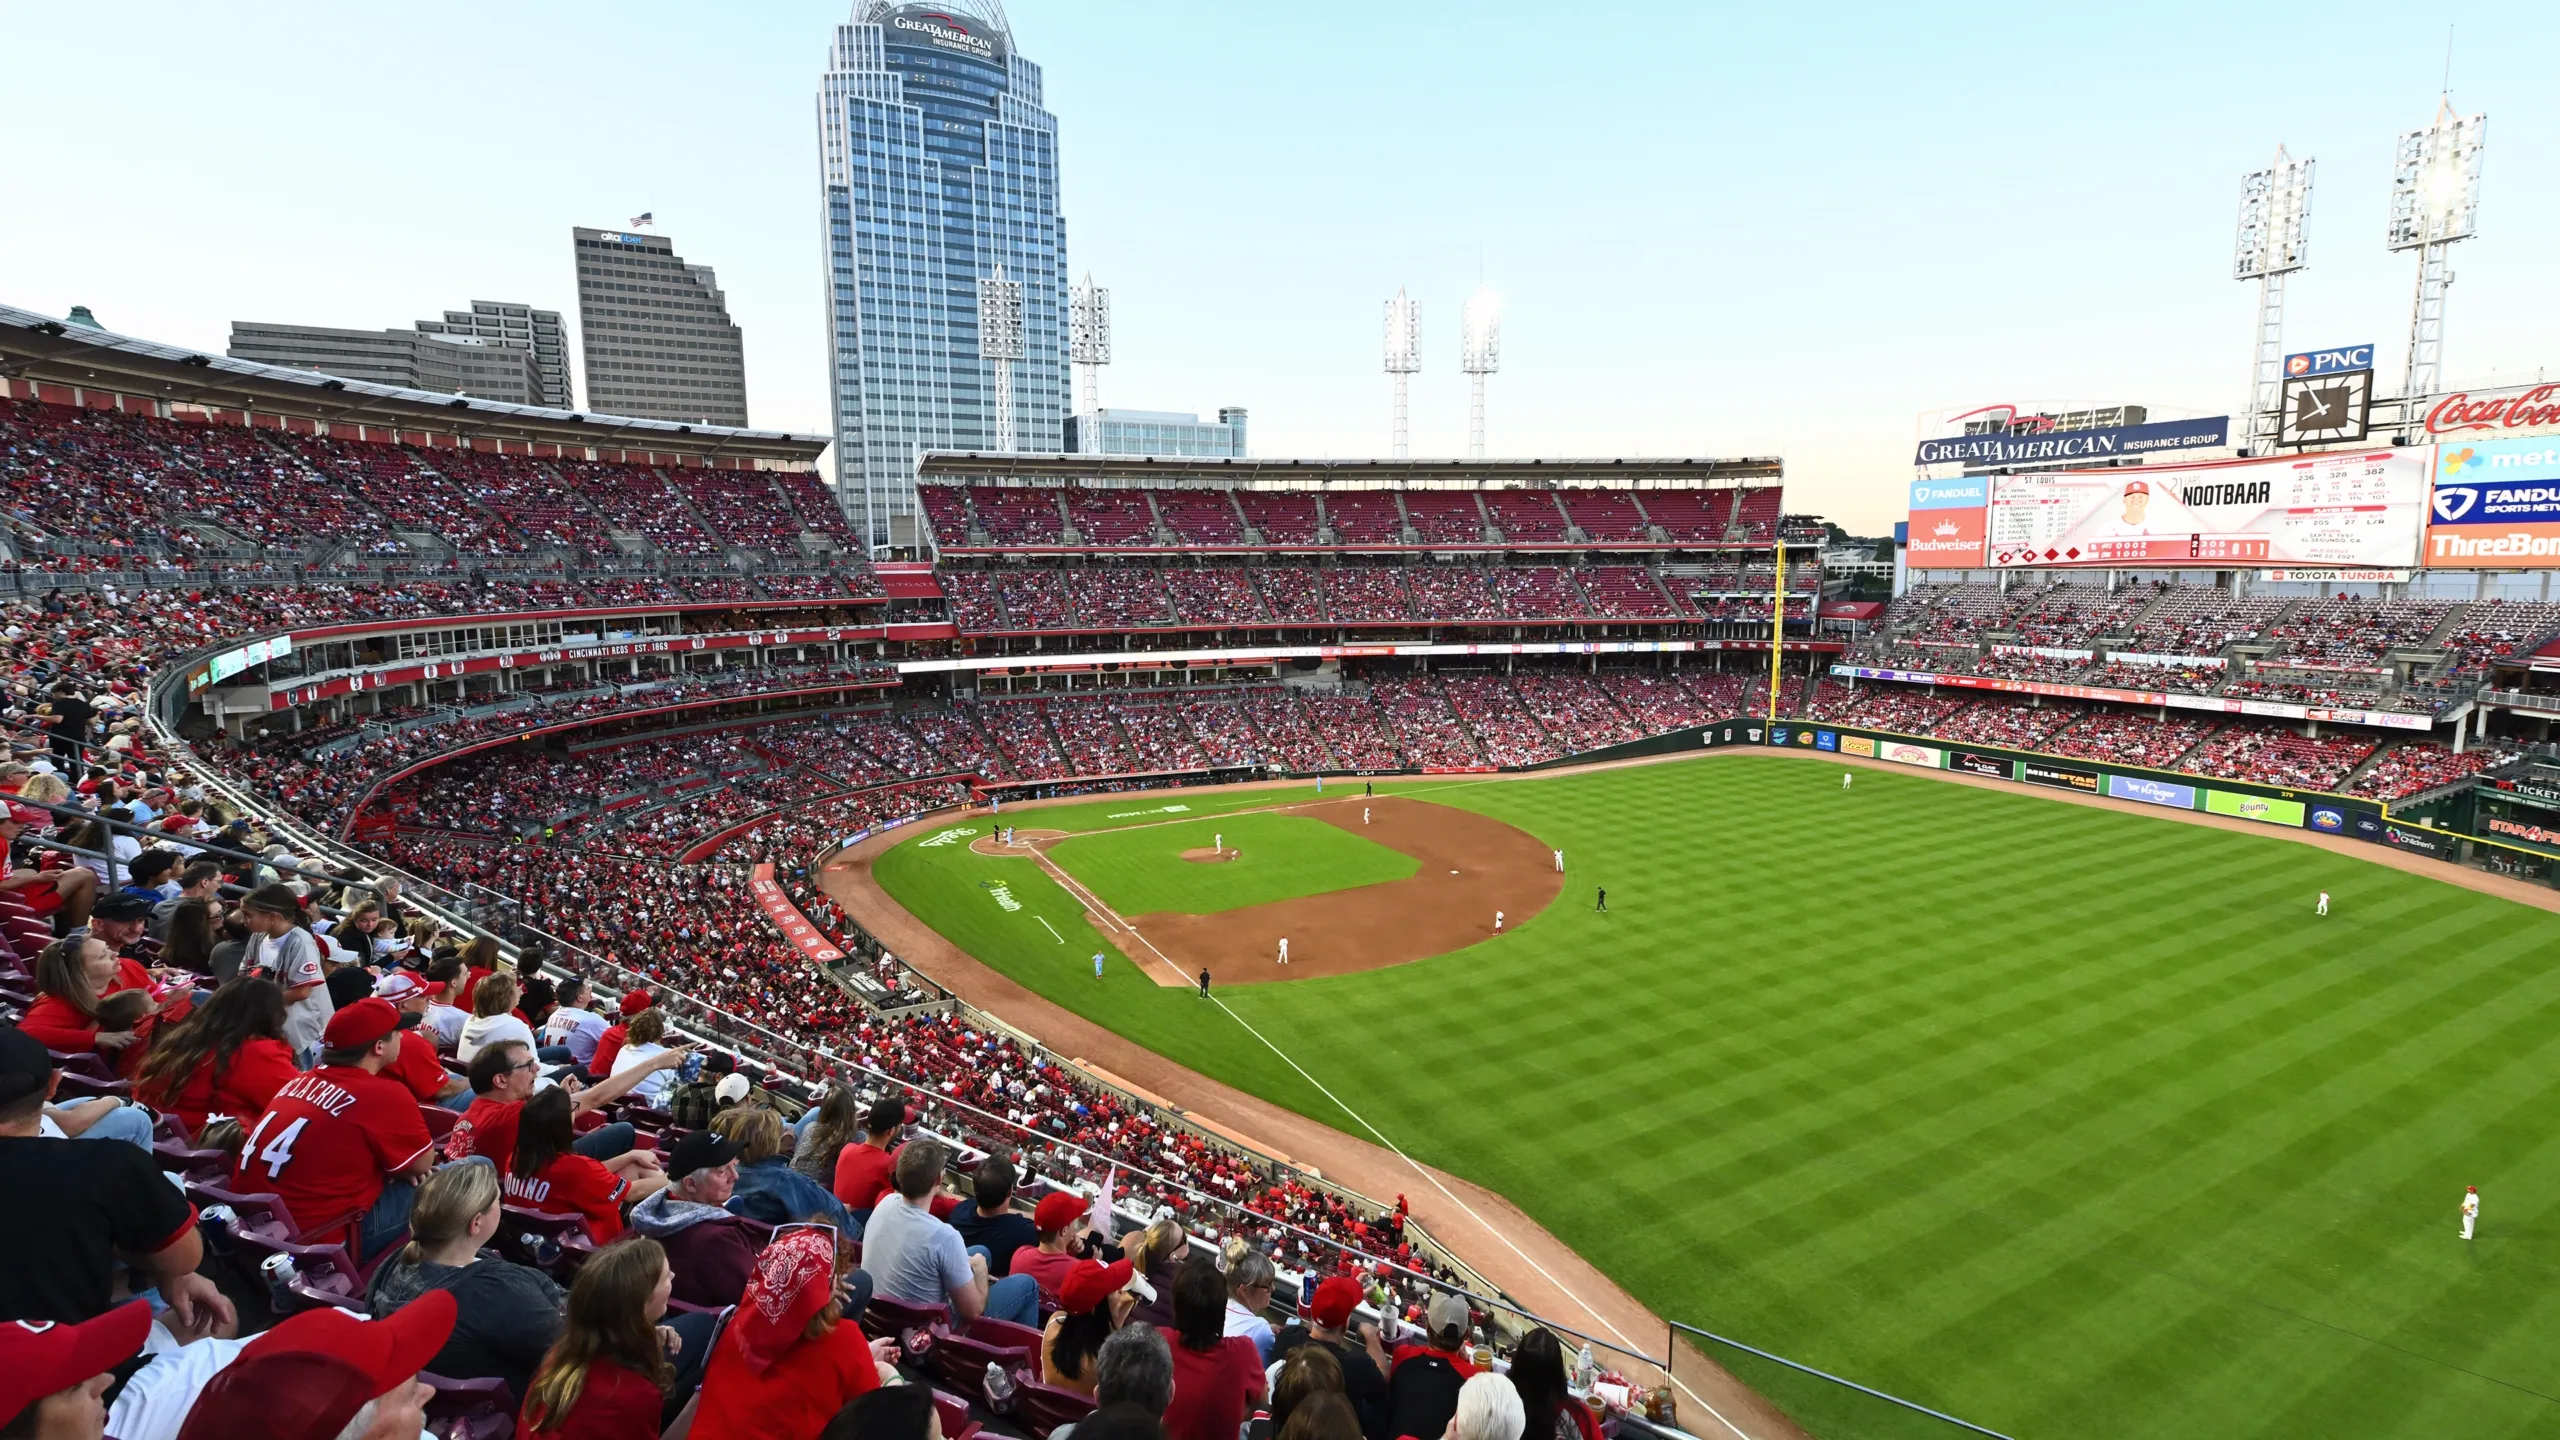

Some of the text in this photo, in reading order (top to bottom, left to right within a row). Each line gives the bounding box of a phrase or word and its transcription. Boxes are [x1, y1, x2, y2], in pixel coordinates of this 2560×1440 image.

[932, 38, 992, 58] INSURANCE GROUP
[601, 232, 643, 244] altafiber
[2313, 348, 2370, 370] PNC
[2124, 434, 2219, 450] INSURANCE GROUP
[2491, 449, 2560, 468] met
[2362, 468, 2385, 476] .382
[2036, 476, 2055, 484] LOUIS
[1932, 487, 1982, 499] FANDUEL
[2182, 481, 2271, 506] NOOTBAAR
[2484, 505, 2531, 513] SPORTS
[1910, 538, 1982, 551] Budweiser
[2289, 571, 2395, 580] TOYOTA TUNDRA
[751, 635, 760, 645] 13
[569, 648, 609, 659] CINCINNATI
[611, 645, 628, 654] REDS
[635, 643, 650, 653] EST.
[652, 642, 668, 651] 1869
[502, 655, 514, 668] 24
[2379, 714, 2415, 726] ROSE
[2071, 781, 2096, 789] TIRES
[2141, 783, 2176, 801] Kroger
[2517, 785, 2560, 800] TICKET
[2240, 803, 2269, 812] Bounty
[2489, 819, 2526, 837] STAR
[2400, 836, 2436, 850] Children's
[240, 1110, 309, 1178] 44
